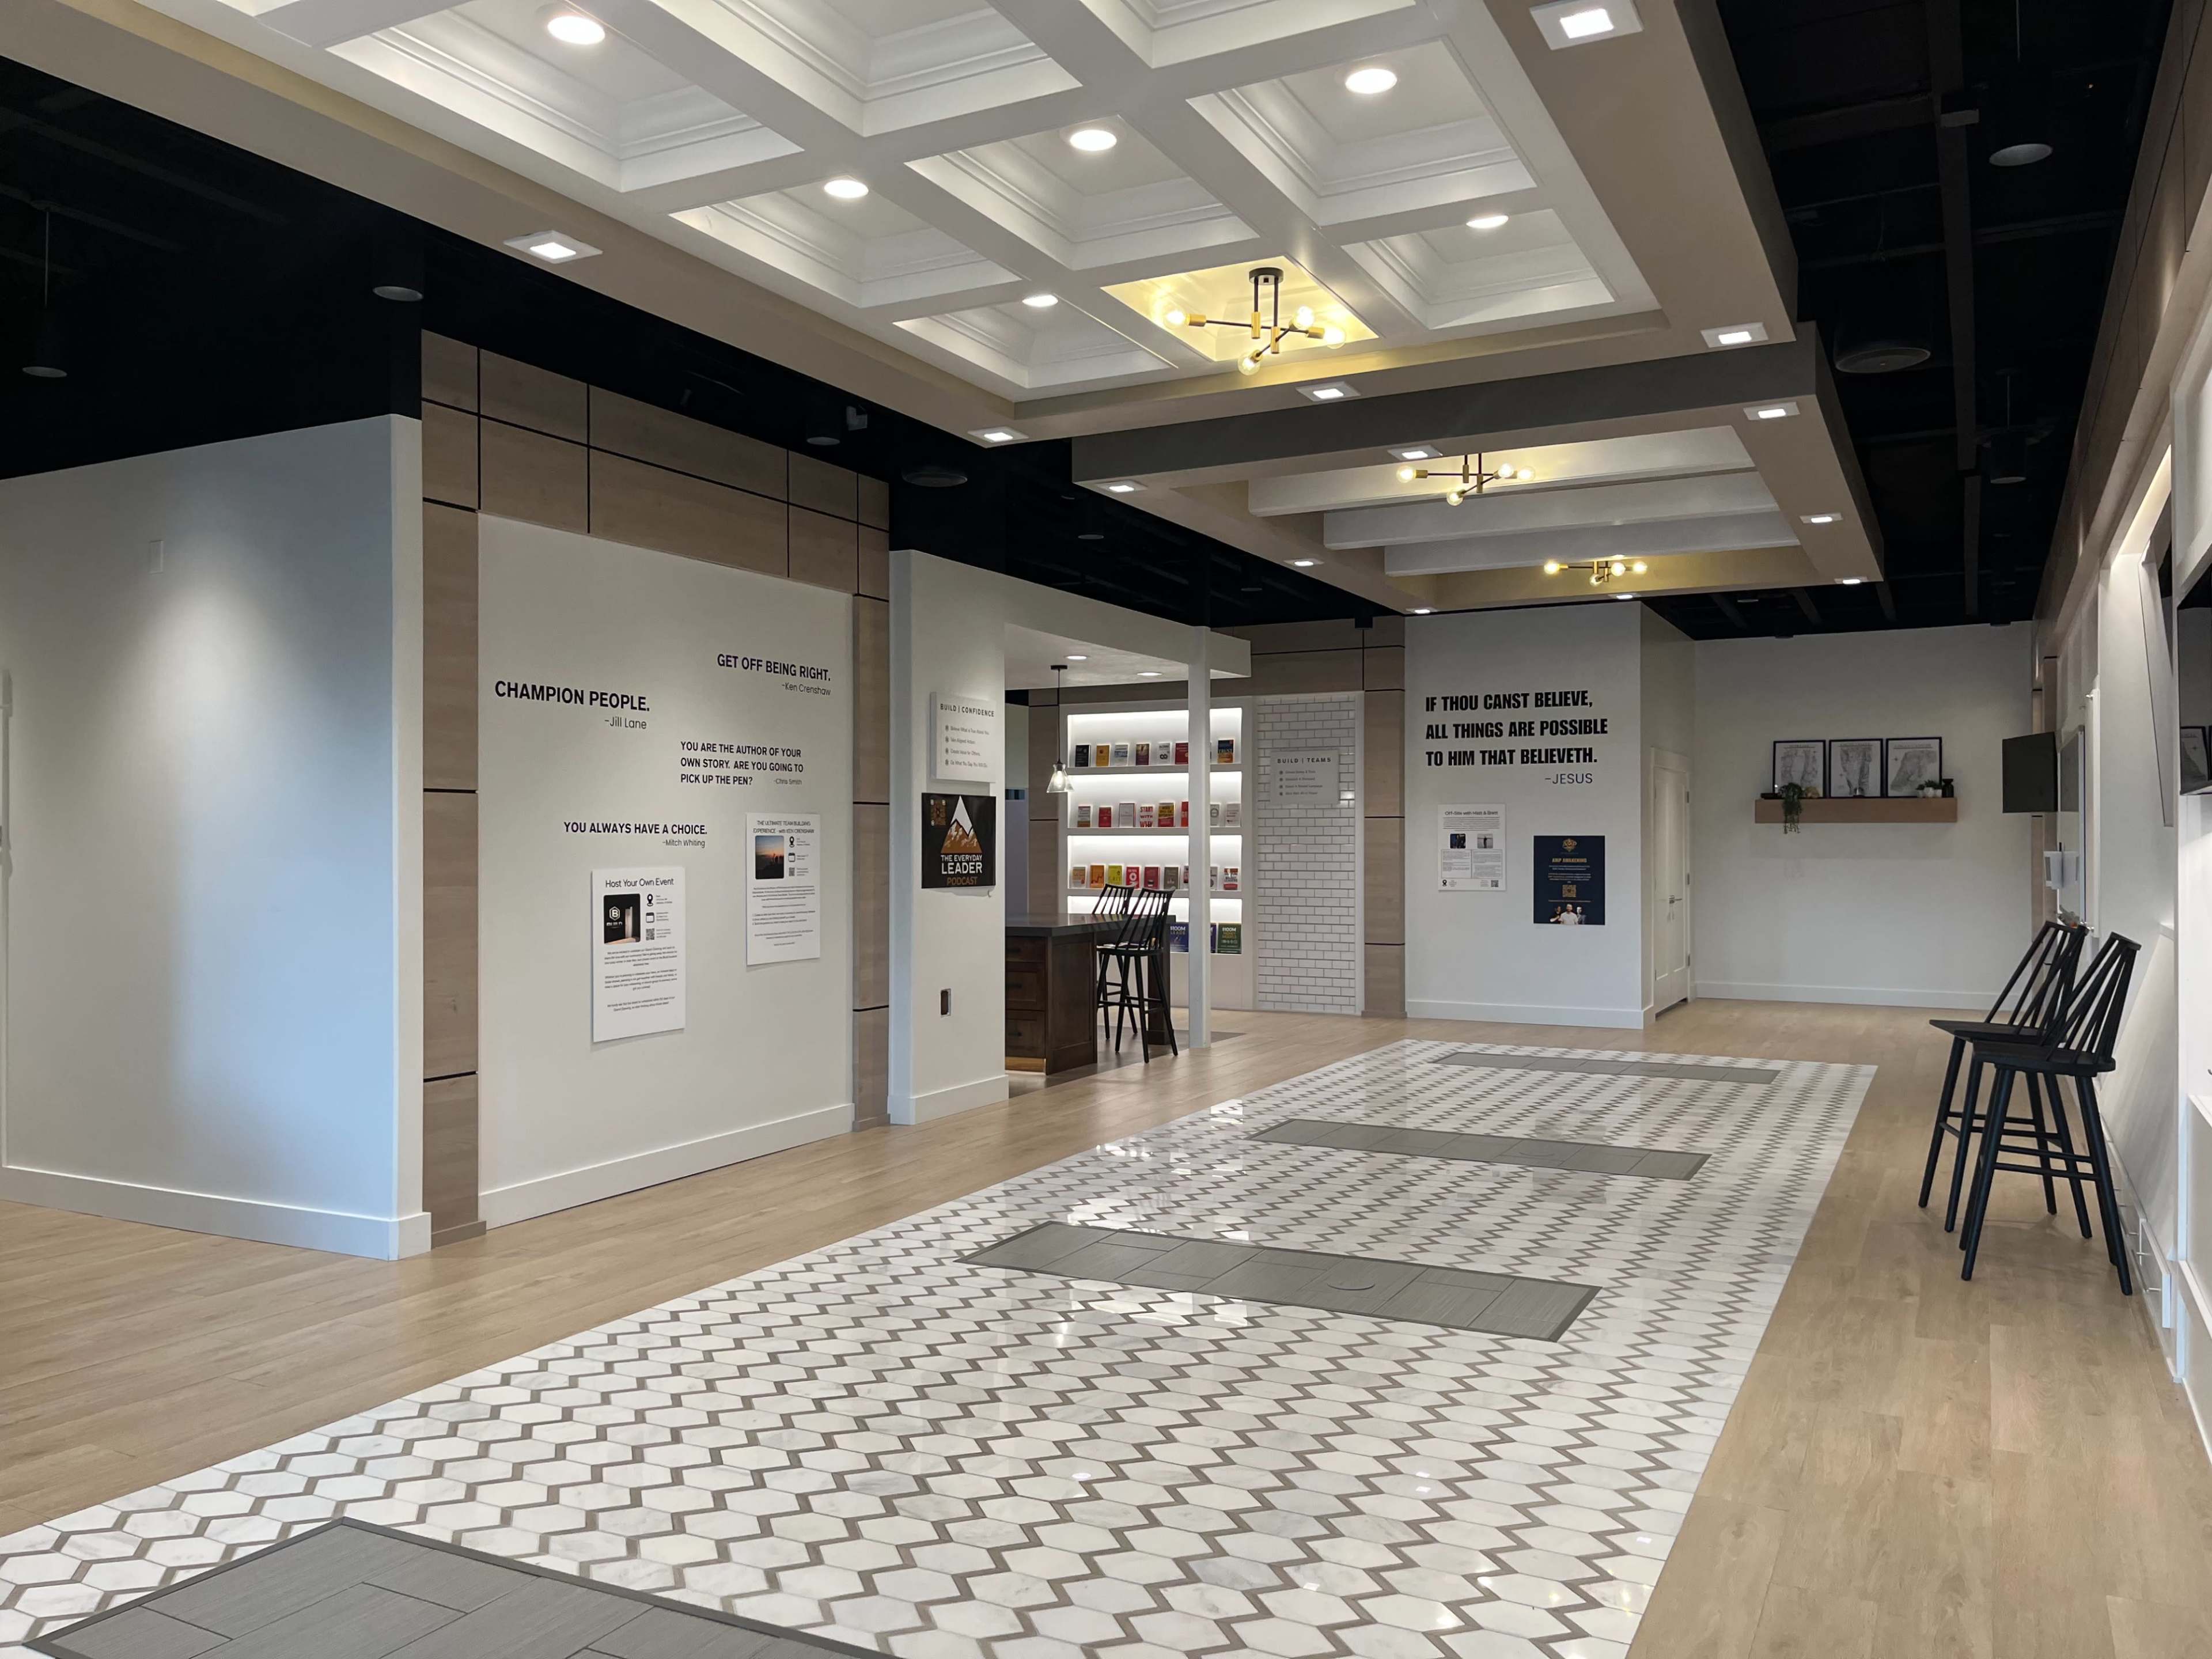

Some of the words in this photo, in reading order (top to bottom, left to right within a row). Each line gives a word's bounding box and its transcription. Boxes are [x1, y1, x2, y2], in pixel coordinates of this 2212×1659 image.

[717, 654, 738, 668] GET
[742, 657, 763, 671] OFF
[766, 661, 796, 676] BEING
[800, 666, 831, 681] RIGHT.
[495, 681, 584, 704] CHAMPION
[589, 691, 650, 711] PEOPLE.
[782, 683, 797, 692] -Ken
[799, 684, 831, 696] Crenshaw
[1425, 697, 1437, 711] IF
[1441, 695, 1478, 711] THOU
[1484, 693, 1529, 710] CANST
[1535, 690, 1593, 708] BELIEVE,
[940, 703, 956, 711] BUILD
[961, 706, 994, 717] CONFIDENCE
[605, 717, 622, 727] -Jill
[624, 718, 647, 729] Lane
[1425, 724, 1448, 739] ALL
[1453, 722, 1503, 738] THINGS
[1508, 721, 1535, 737] ARE
[1540, 719, 1608, 736] POSSIBLE
[681, 741, 698, 751] YOU
[700, 743, 717, 752] ARE
[719, 744, 734, 753] THE
[736, 745, 767, 755] AUTHOR
[769, 748, 779, 756] OF
[781, 749, 801, 757] YOUR
[1426, 751, 1443, 766] TO
[1448, 751, 1475, 766] HIM
[1479, 749, 1516, 765] THAT
[1521, 748, 1597, 764] BELIEVETH.
[681, 757, 700, 767] OWN
[703, 759, 730, 769] STORY.
[734, 761, 749, 770] ARE
[751, 762, 767, 771] YOU
[770, 763, 792, 772] GOING
[794, 764, 804, 772] TO
[681, 774, 700, 783] PICK
[702, 774, 713, 784] UP
[715, 775, 730, 785] THE
[733, 776, 753, 785] PEN?
[563, 822, 586, 832] YOU
[589, 823, 631, 834] ALWAYS
[634, 824, 660, 834] HAVE
[662, 824, 669, 834] A
[671, 824, 707, 835] CHOICE.
[683, 839, 705, 849] Whiting
[941, 862, 982, 874] LEADER
[605, 880, 622, 888] Host
[623, 878, 638, 887] Your
[639, 878, 654, 887] Own
[656, 877, 674, 886] Event
[947, 876, 978, 885] PODCAST
